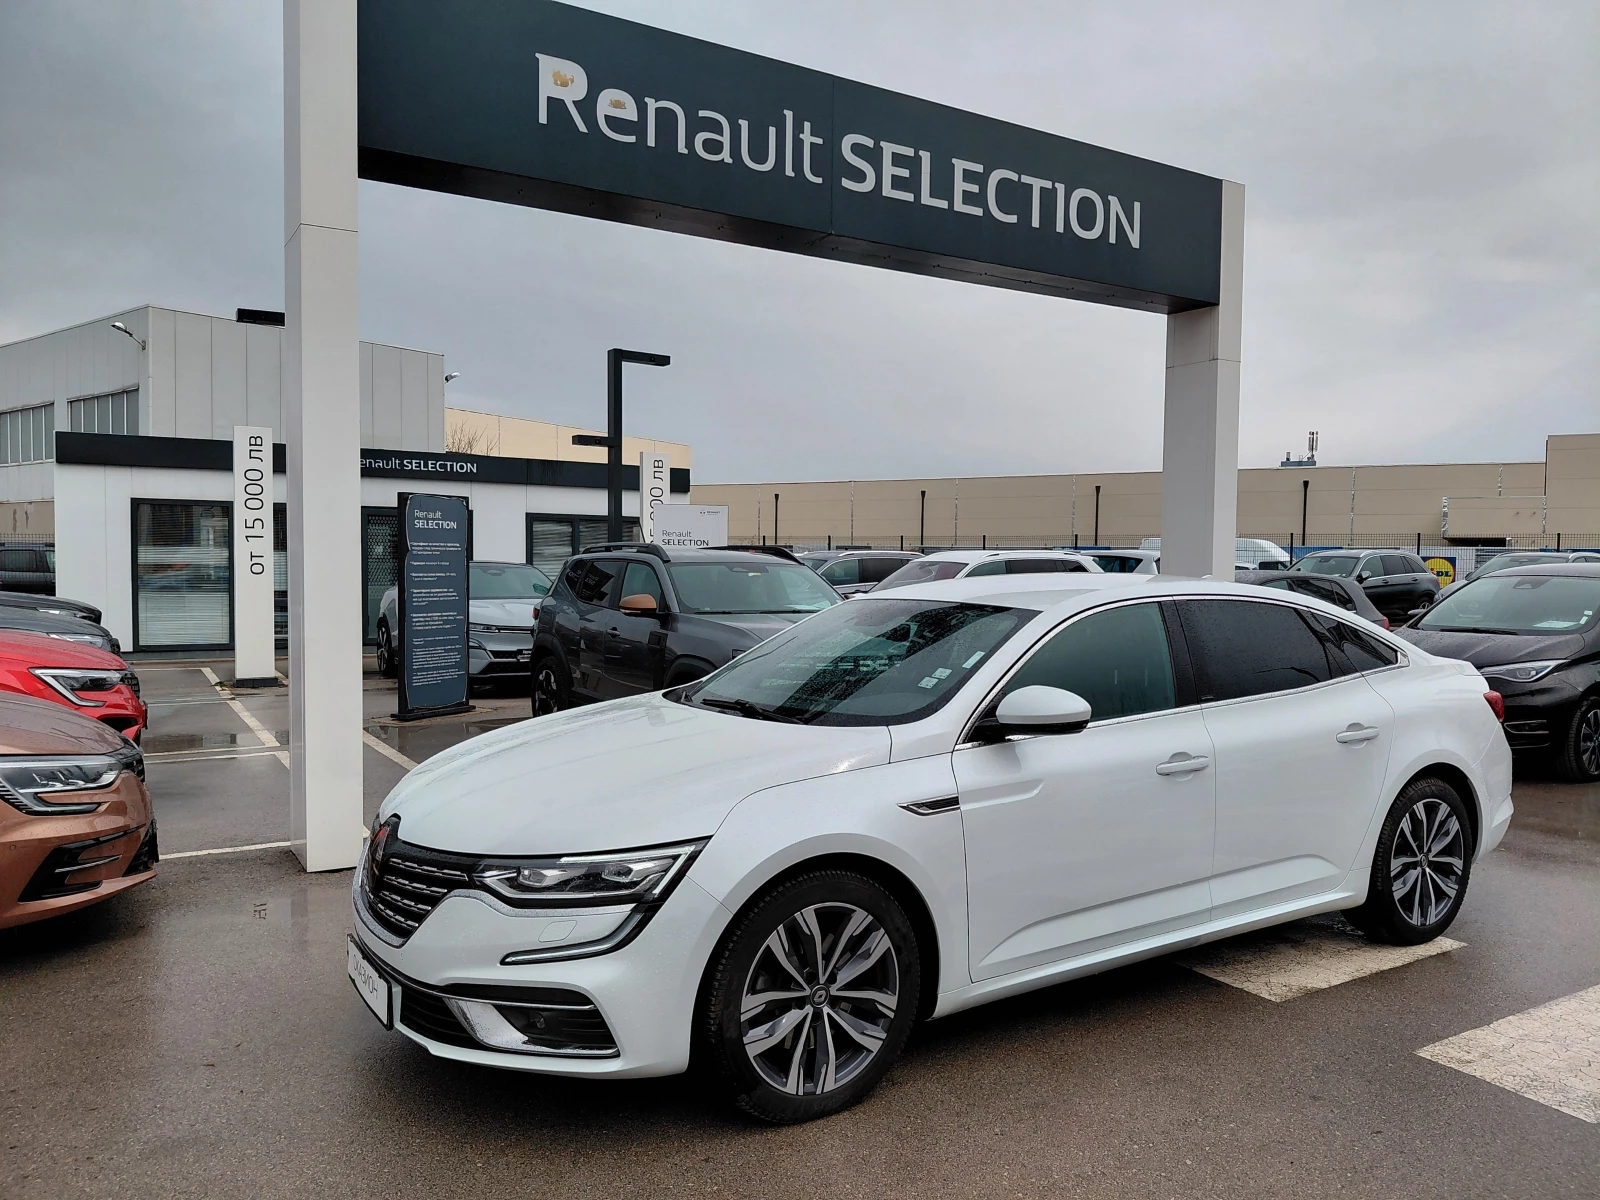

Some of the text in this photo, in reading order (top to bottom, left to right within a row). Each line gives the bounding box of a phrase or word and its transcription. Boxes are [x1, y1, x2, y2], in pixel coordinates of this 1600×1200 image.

[534, 51, 1143, 250] Renault SELECTION
[360, 457, 477, 474] enault SELECTION
[244, 468, 265, 511] 000
[414, 509, 442, 519] Renault
[245, 518, 265, 543] 15
[414, 519, 457, 530] SELECTION
[661, 529, 692, 538] Renault
[661, 539, 709, 547] SELECTION
